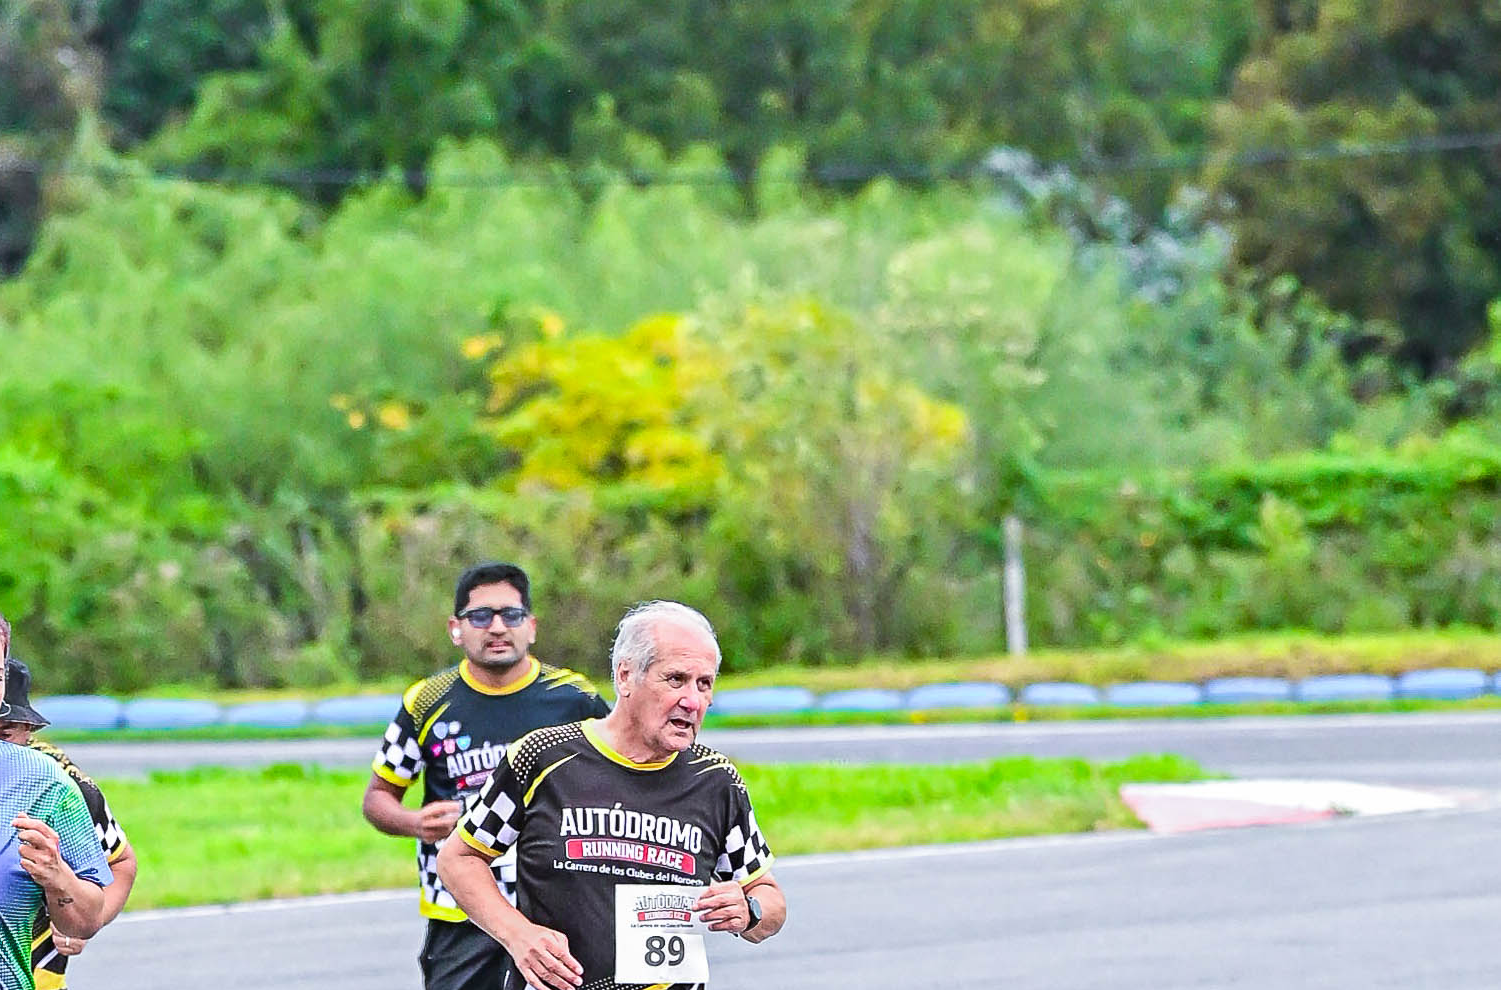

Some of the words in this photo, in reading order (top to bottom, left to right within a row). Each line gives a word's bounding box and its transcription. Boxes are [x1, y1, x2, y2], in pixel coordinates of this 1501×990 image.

[447, 741, 508, 778] AUTÓD
[559, 802, 703, 854] AUTÓDROMO
[553, 860, 565, 869] La
[564, 861, 598, 873] Carrera
[598, 864, 611, 874] de
[611, 866, 625, 876] los
[626, 867, 655, 880] Clubes
[655, 870, 670, 882] del
[581, 841, 644, 861] RUNNING
[646, 846, 684, 870] RACE
[644, 935, 685, 967] 89
